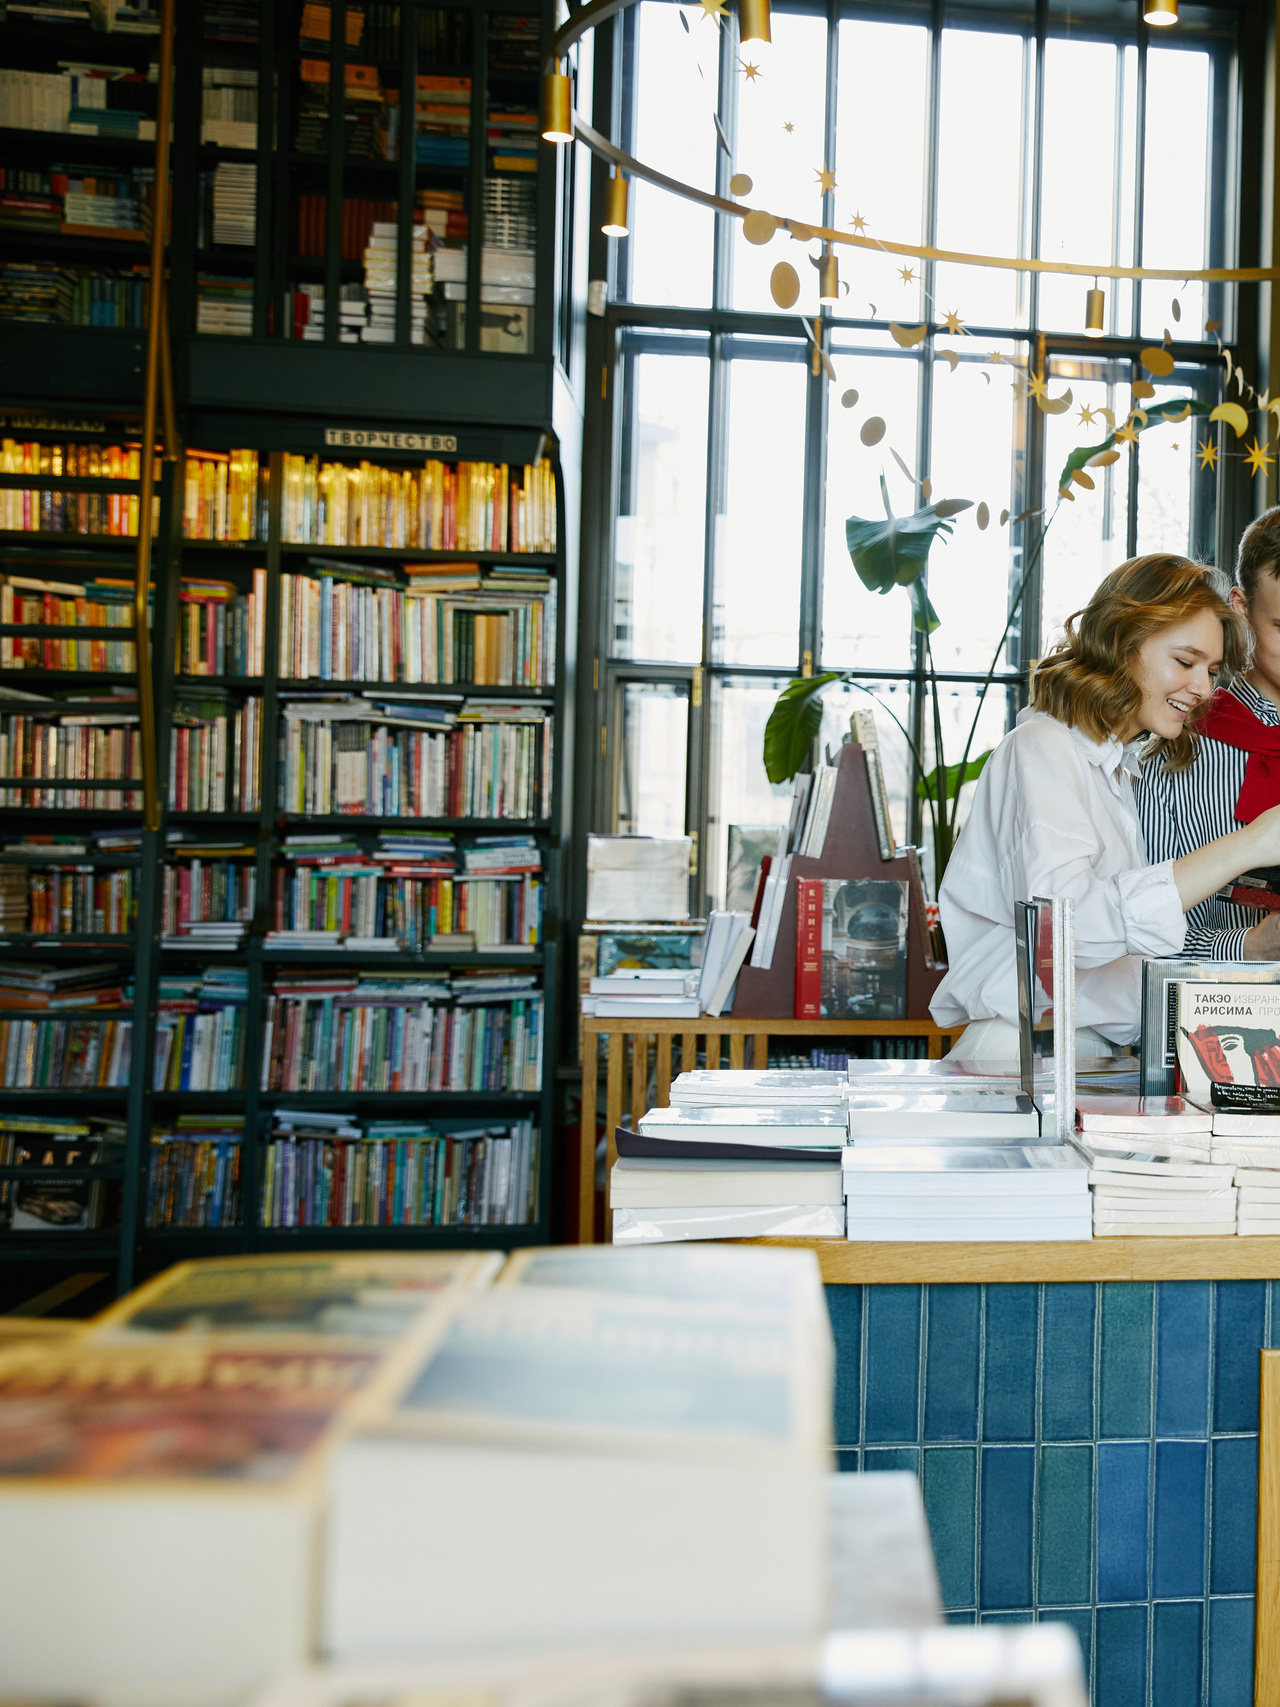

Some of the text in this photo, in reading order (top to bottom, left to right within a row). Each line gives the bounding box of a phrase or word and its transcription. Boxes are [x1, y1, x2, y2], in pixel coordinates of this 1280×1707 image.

[328, 431, 456, 450] ТВОРЧЕСТВО
[1195, 994, 1231, 1003] ТАКЭО
[1194, 1007, 1252, 1015] АРИСИМА
